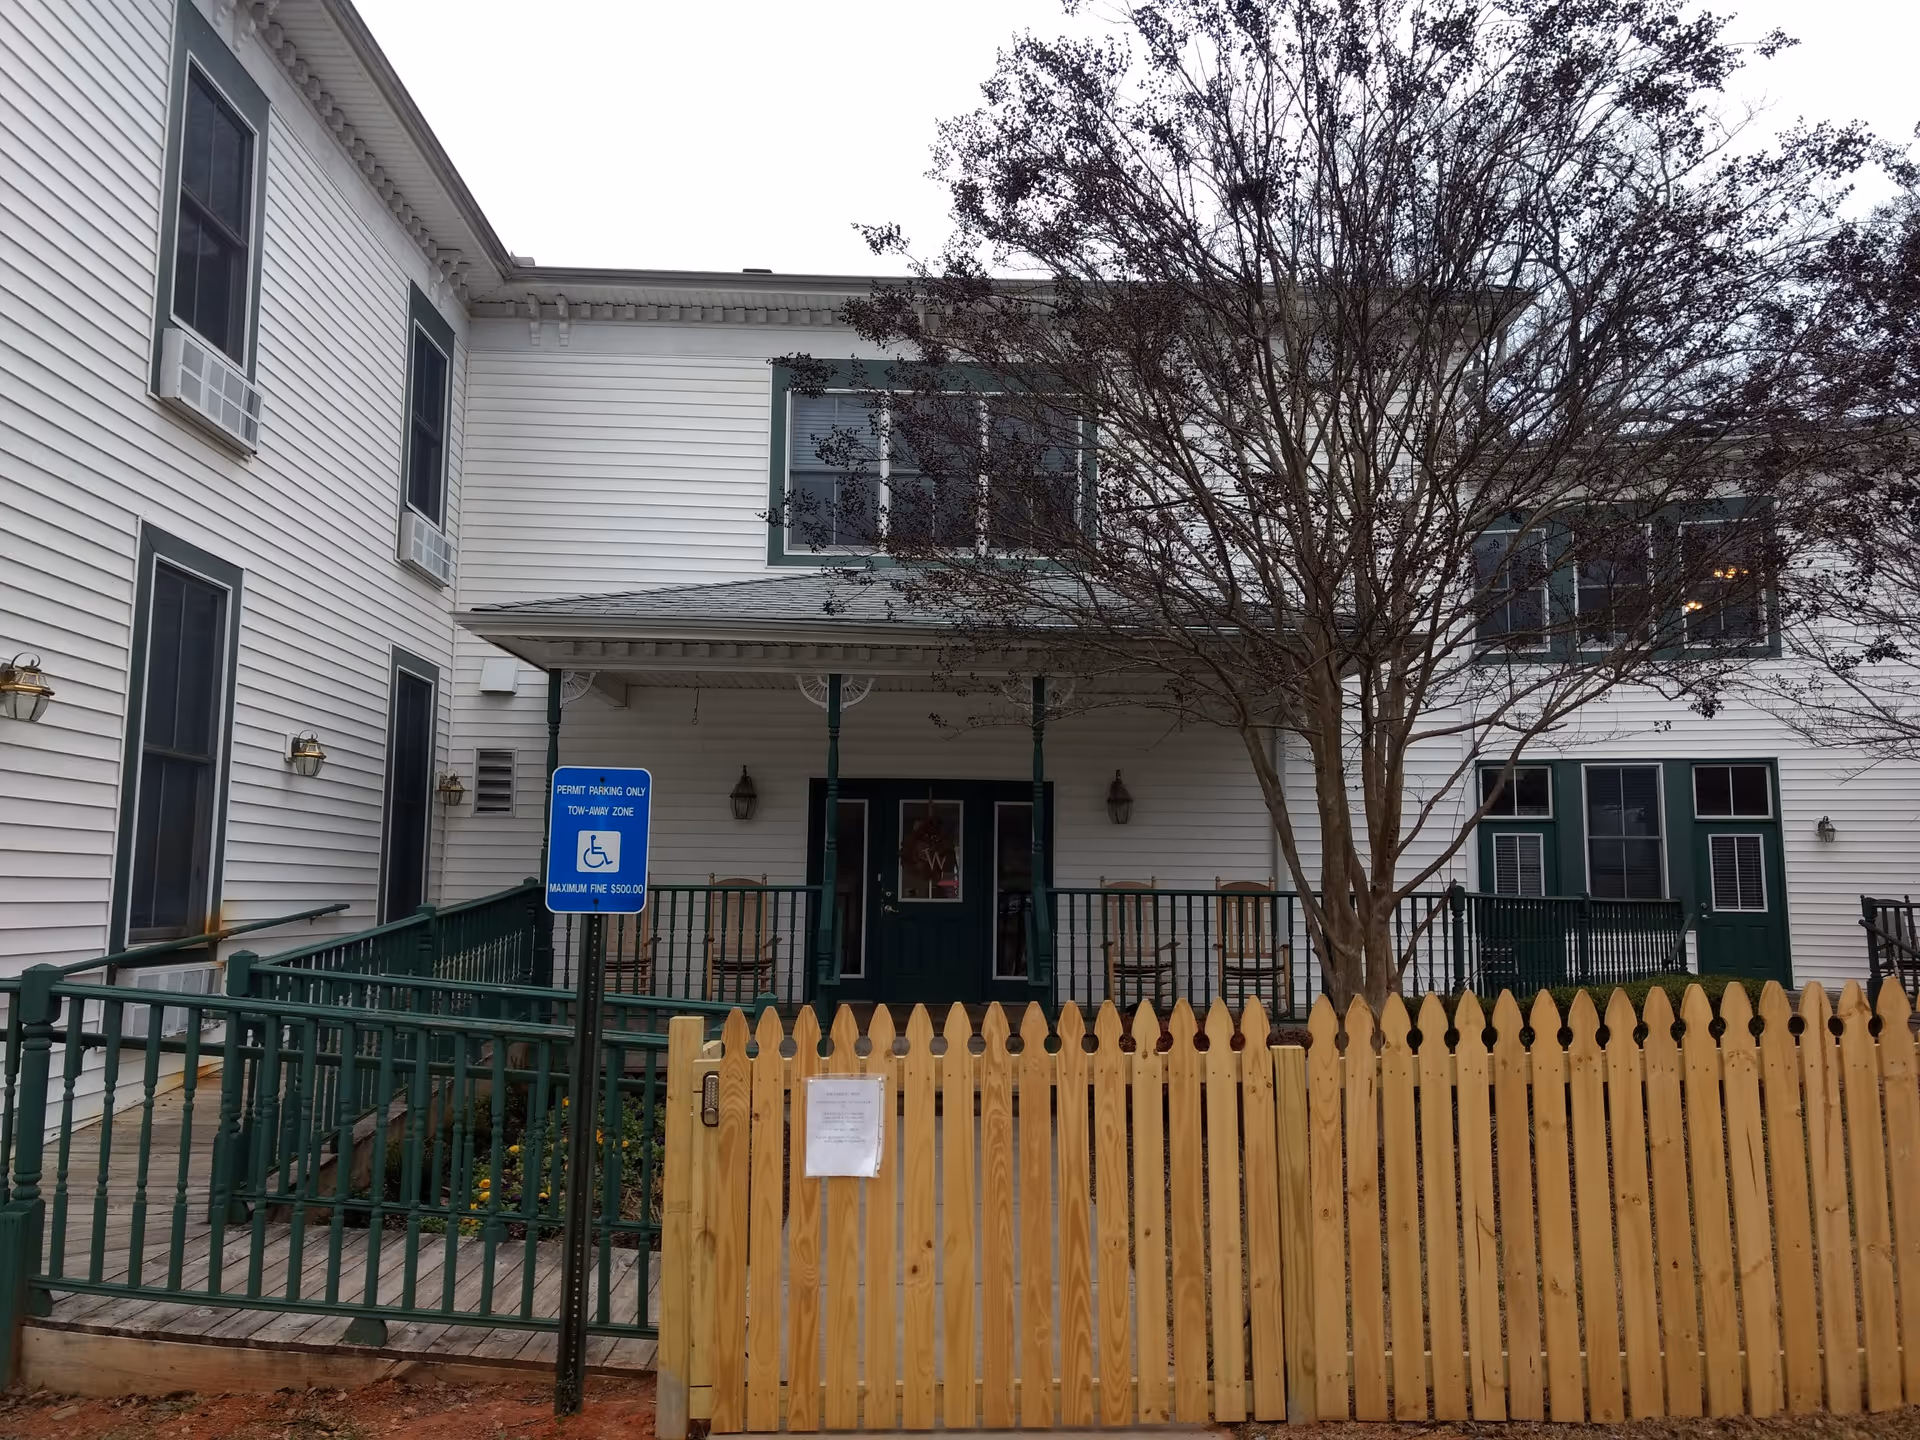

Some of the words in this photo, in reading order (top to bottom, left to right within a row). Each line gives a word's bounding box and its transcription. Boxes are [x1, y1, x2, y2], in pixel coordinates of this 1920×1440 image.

[556, 784, 586, 795] PERMIT
[588, 786, 623, 796] PARKING
[625, 786, 646, 796] ONLY
[567, 805, 609, 815] TOW-AWAY
[612, 806, 634, 816] ZONE
[921, 848, 947, 870] W
[549, 883, 587, 893] MAXIMUM
[590, 883, 607, 893] FINE
[610, 884, 644, 894] $500.00
